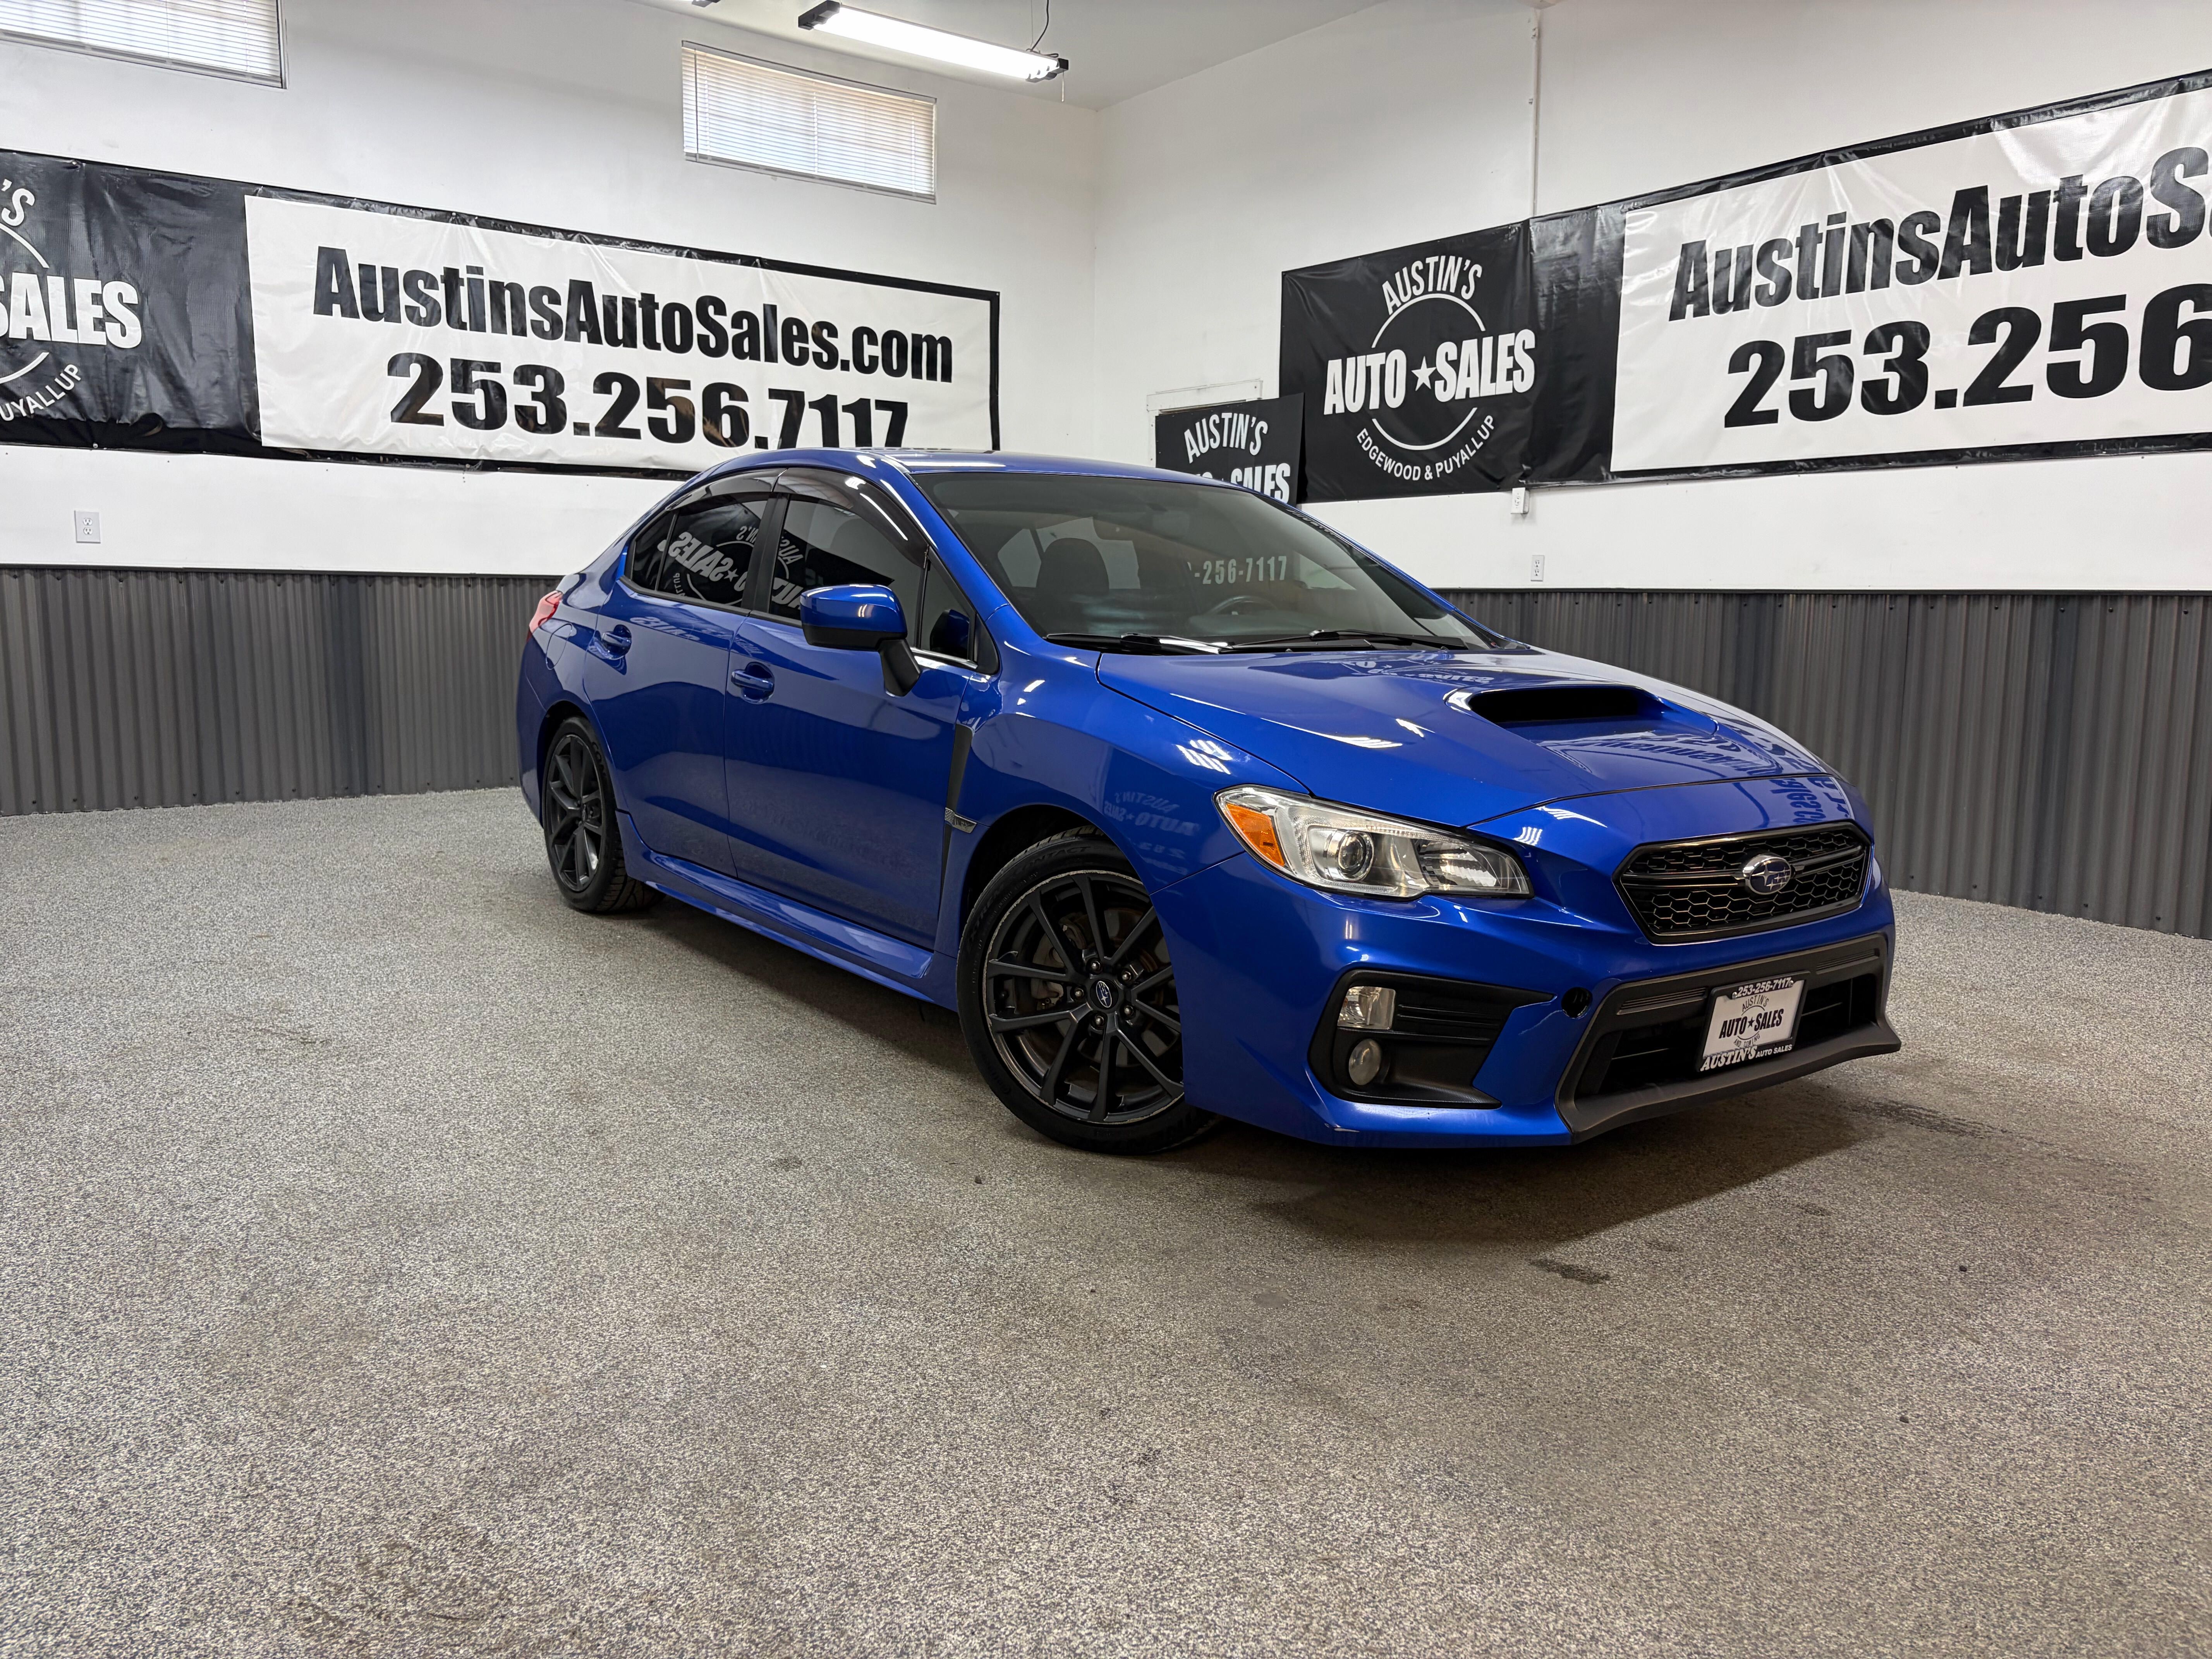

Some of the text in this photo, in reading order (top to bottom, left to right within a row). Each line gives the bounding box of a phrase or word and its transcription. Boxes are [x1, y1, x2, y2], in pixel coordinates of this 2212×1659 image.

[1669, 147, 2212, 321] AustinsAutoS
[0, 272, 142, 348] ALES
[313, 246, 952, 383] AustinsAutoSales.com
[1382, 255, 1482, 316] AUSTIN'S
[1324, 329, 1535, 415] AUTO SALES
[1724, 283, 2212, 428] 253.256
[0, 364, 81, 421] UYALLUP
[388, 353, 908, 449] 253.256.7117
[1184, 412, 1268, 463] AUSTIN'S
[1357, 415, 1494, 481] EDGEWOOD & PUYALLUP
[1187, 556, 1287, 584] -256-7117
[1737, 977, 1791, 998] 253-256-7117
[1742, 994, 1769, 1012] AUSTIN'S
[1719, 1008, 1784, 1039] AUTO SALES
[1700, 1044, 1792, 1072] AUSTIN'S AUTO SALES
